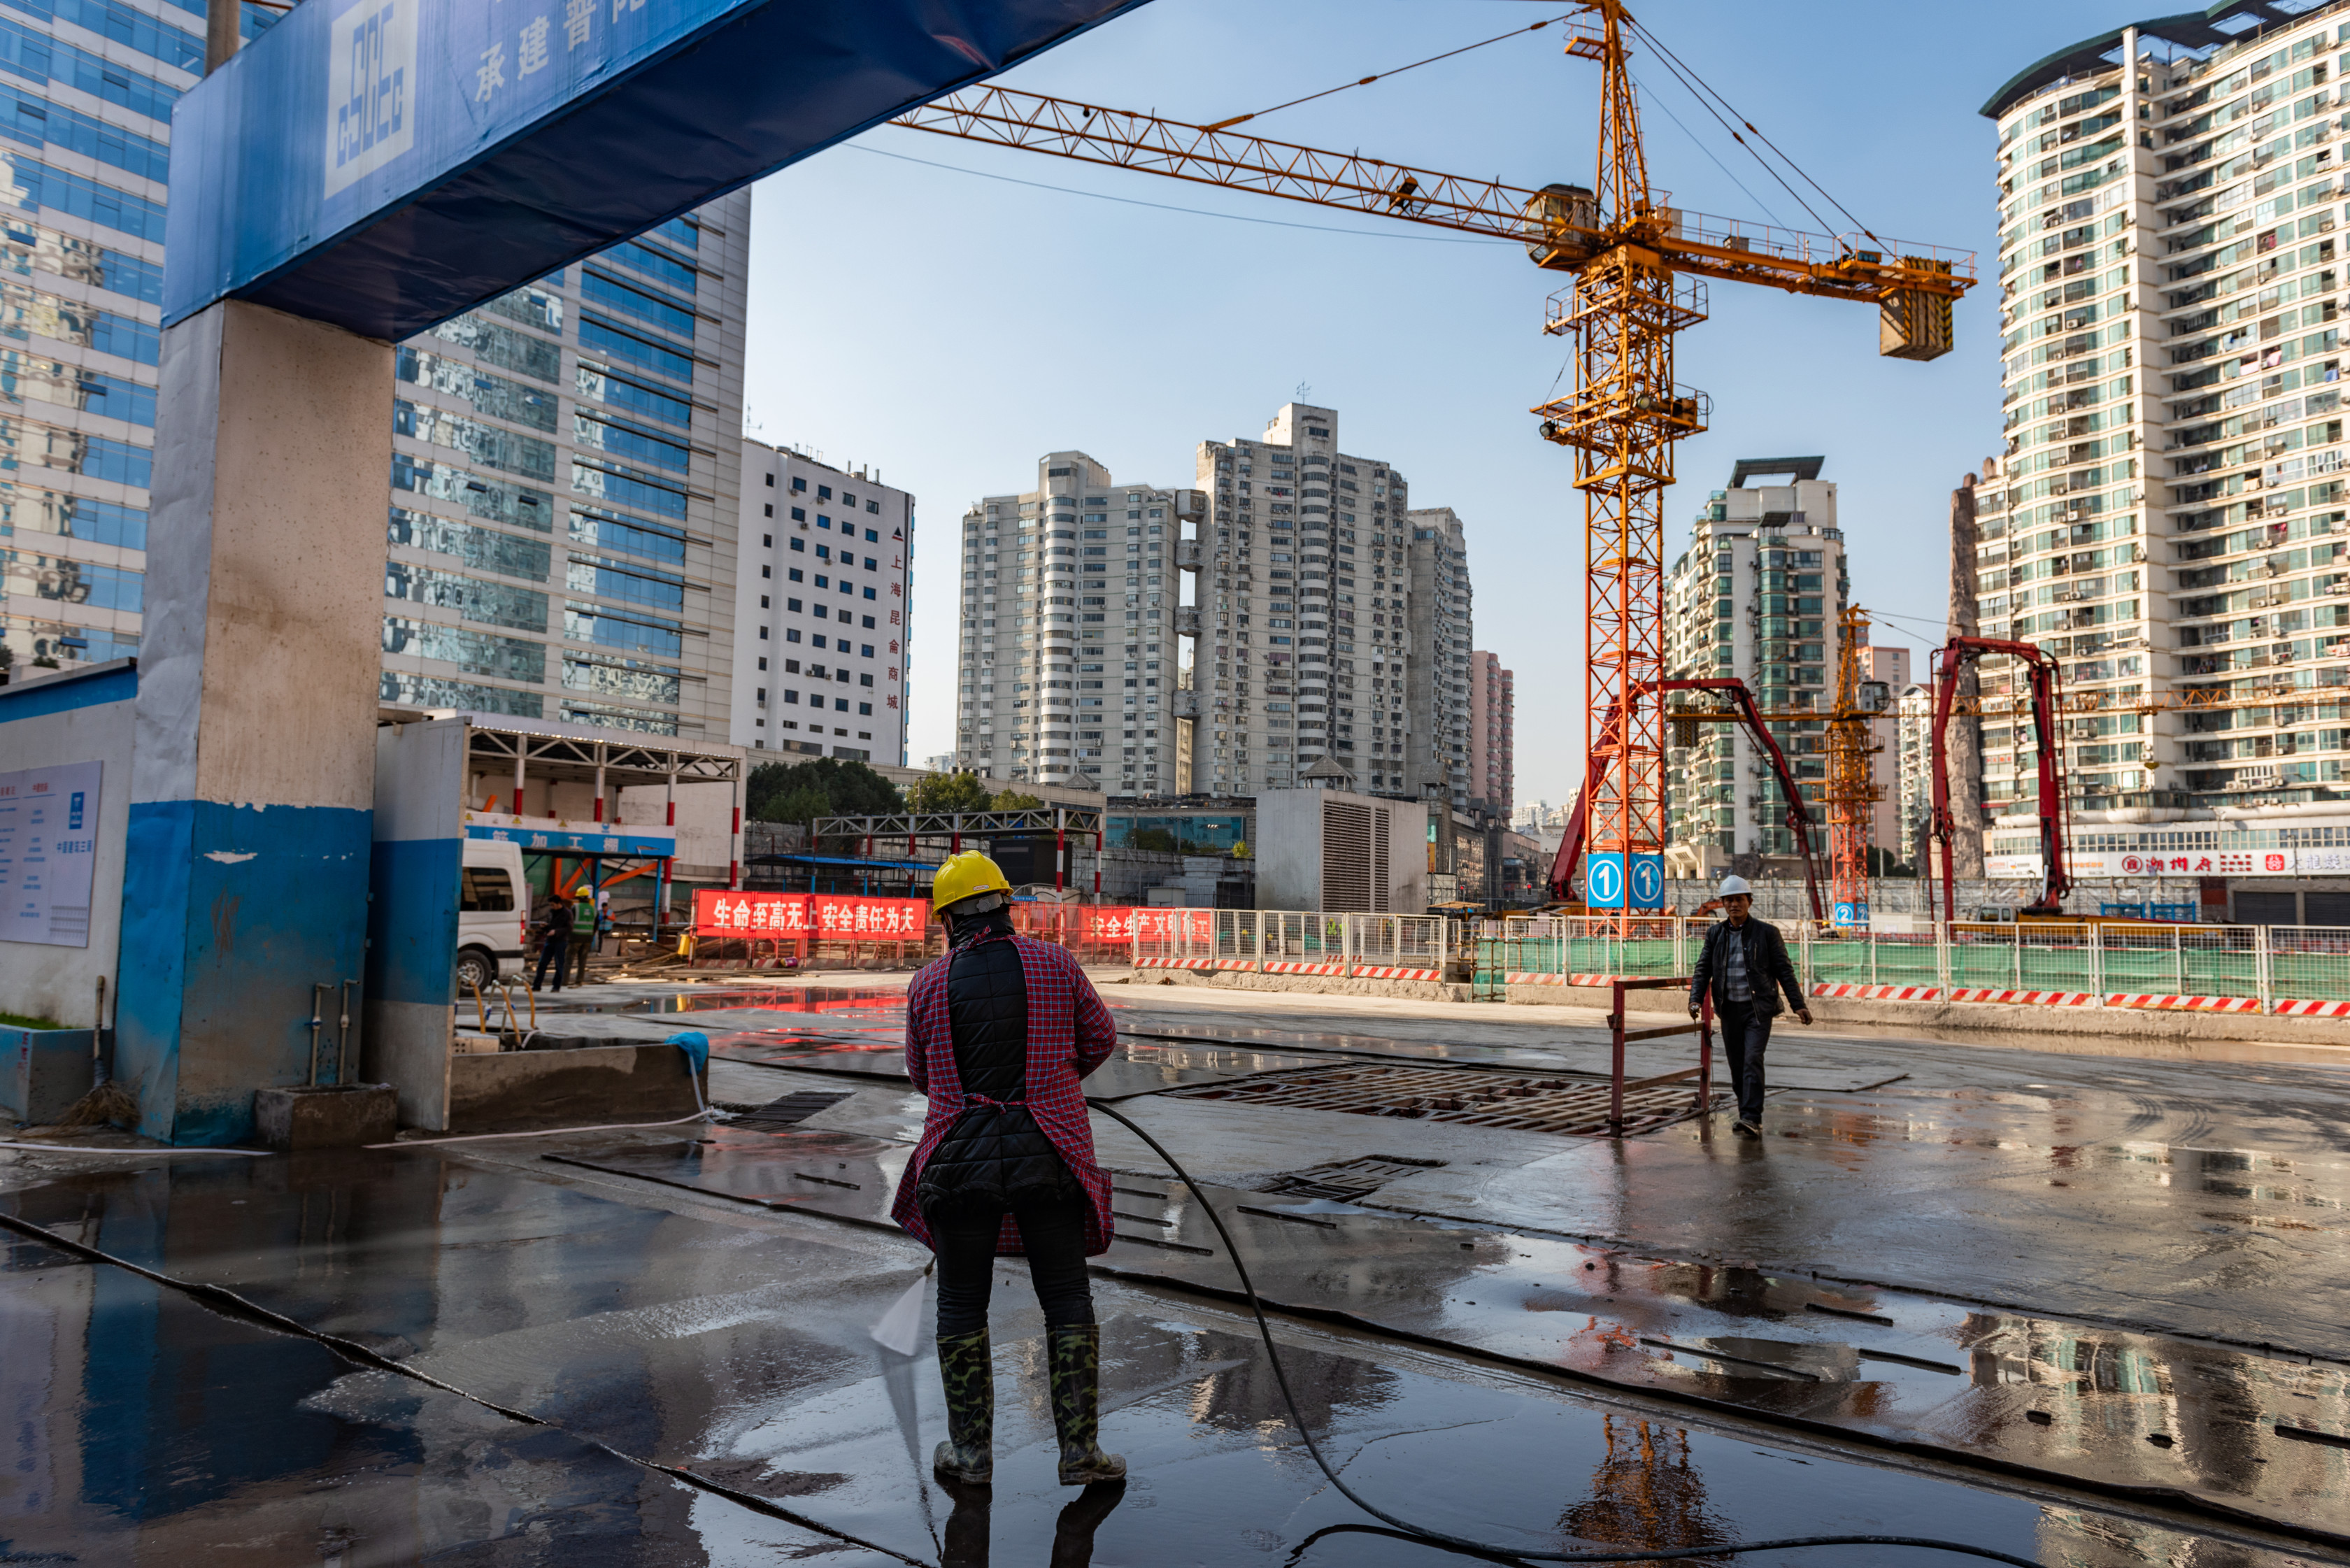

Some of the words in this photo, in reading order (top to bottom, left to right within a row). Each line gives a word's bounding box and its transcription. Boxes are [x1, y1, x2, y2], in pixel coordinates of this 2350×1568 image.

[2288, 854, 2350, 870] 大龍燚
[713, 898, 818, 931] 生命至高无上
[822, 902, 914, 934] 安全责任为天
